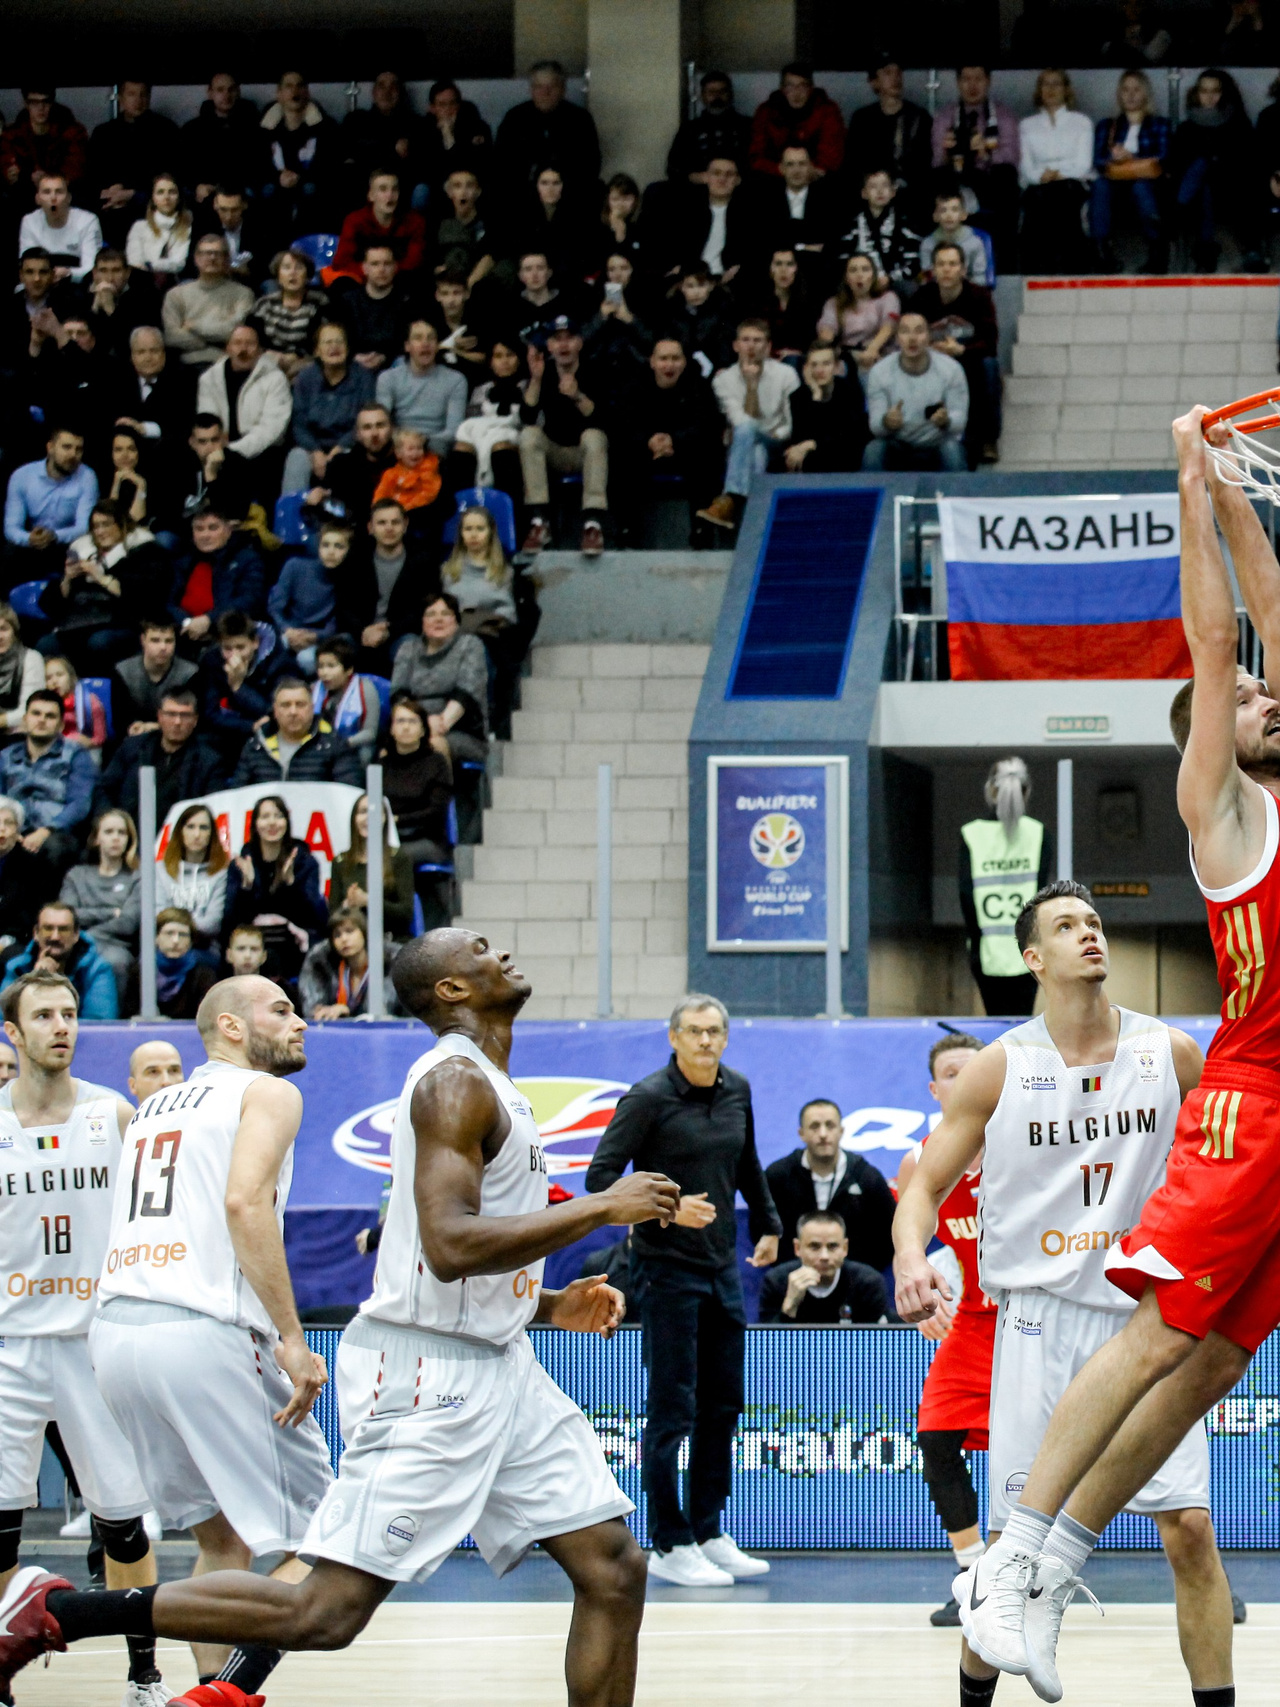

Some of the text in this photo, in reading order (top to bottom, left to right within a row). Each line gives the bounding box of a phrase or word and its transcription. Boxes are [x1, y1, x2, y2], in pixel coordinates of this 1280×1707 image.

[979, 511, 1175, 551] КАЗАНЬ
[1029, 1108, 1156, 1146] BELGIUM
[0, 1166, 109, 1196] ELGIUM
[128, 1130, 182, 1223] 13
[1080, 1162, 1114, 1207] 17
[41, 1215, 71, 1255] 18
[107, 1242, 187, 1274] Orange
[436, 1394, 467, 1402] TARMA
